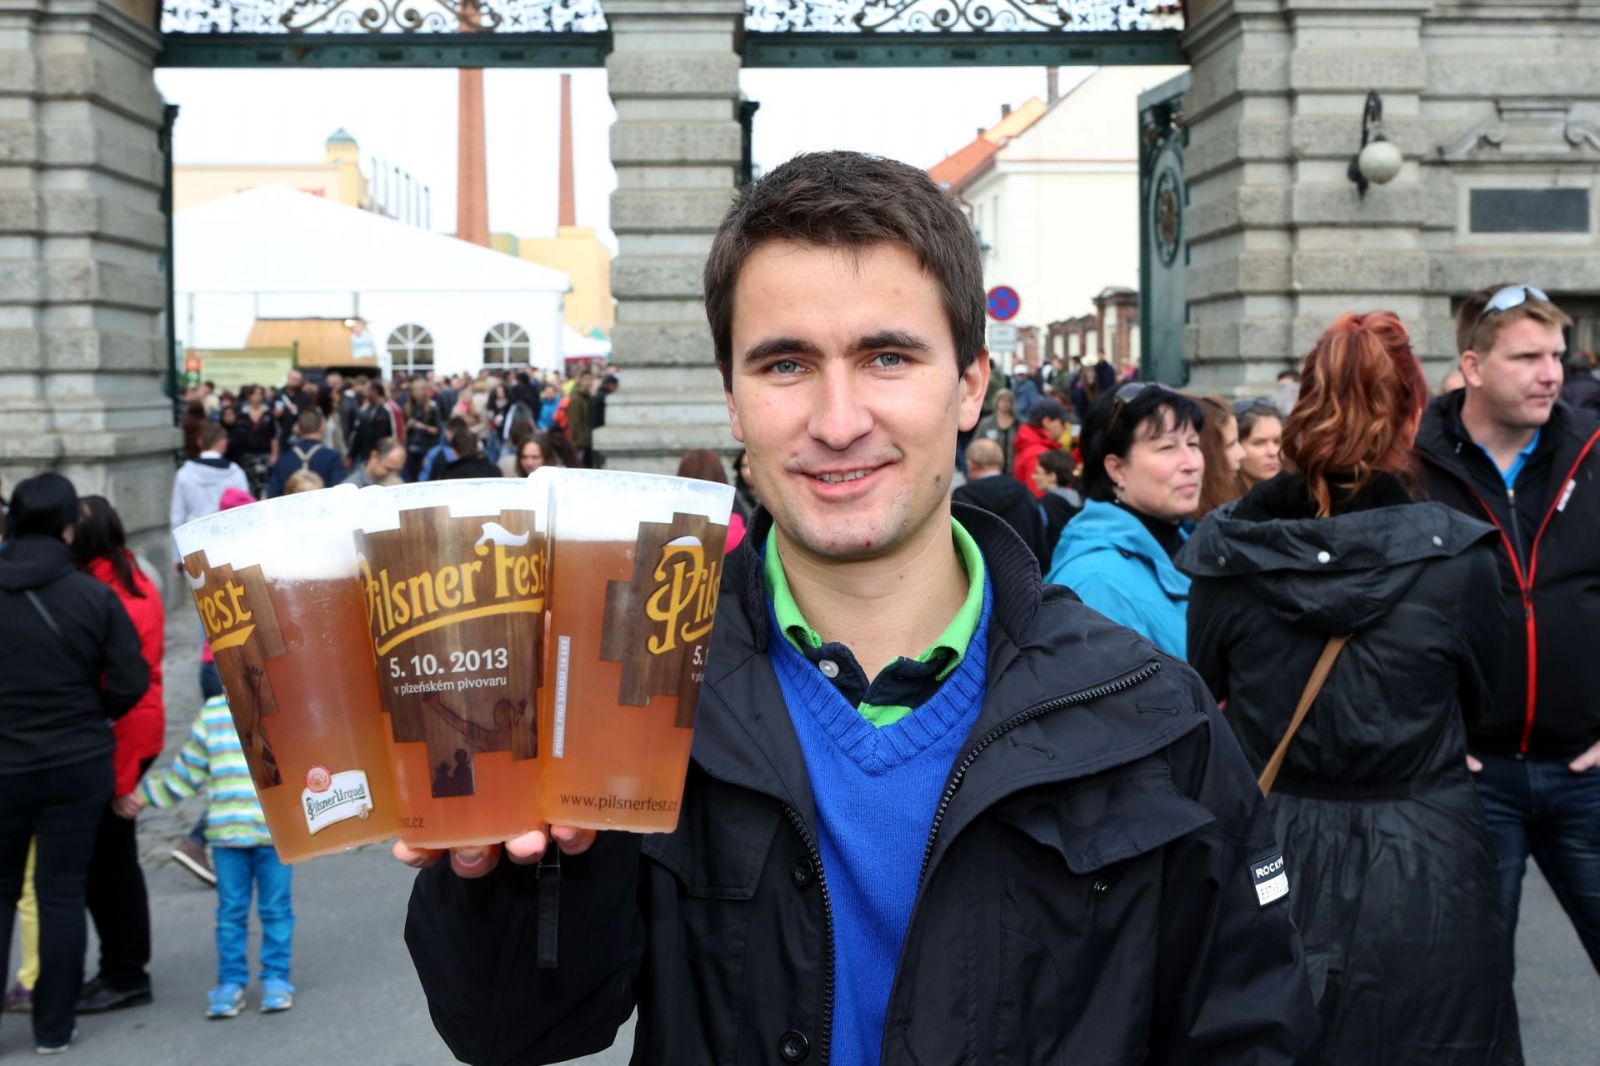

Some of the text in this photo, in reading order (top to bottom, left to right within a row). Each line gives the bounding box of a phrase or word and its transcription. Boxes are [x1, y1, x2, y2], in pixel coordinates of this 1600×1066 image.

[389, 647, 509, 678] 5. 10. 2013
[394, 676, 507, 697] v plzeňském pivovaru
